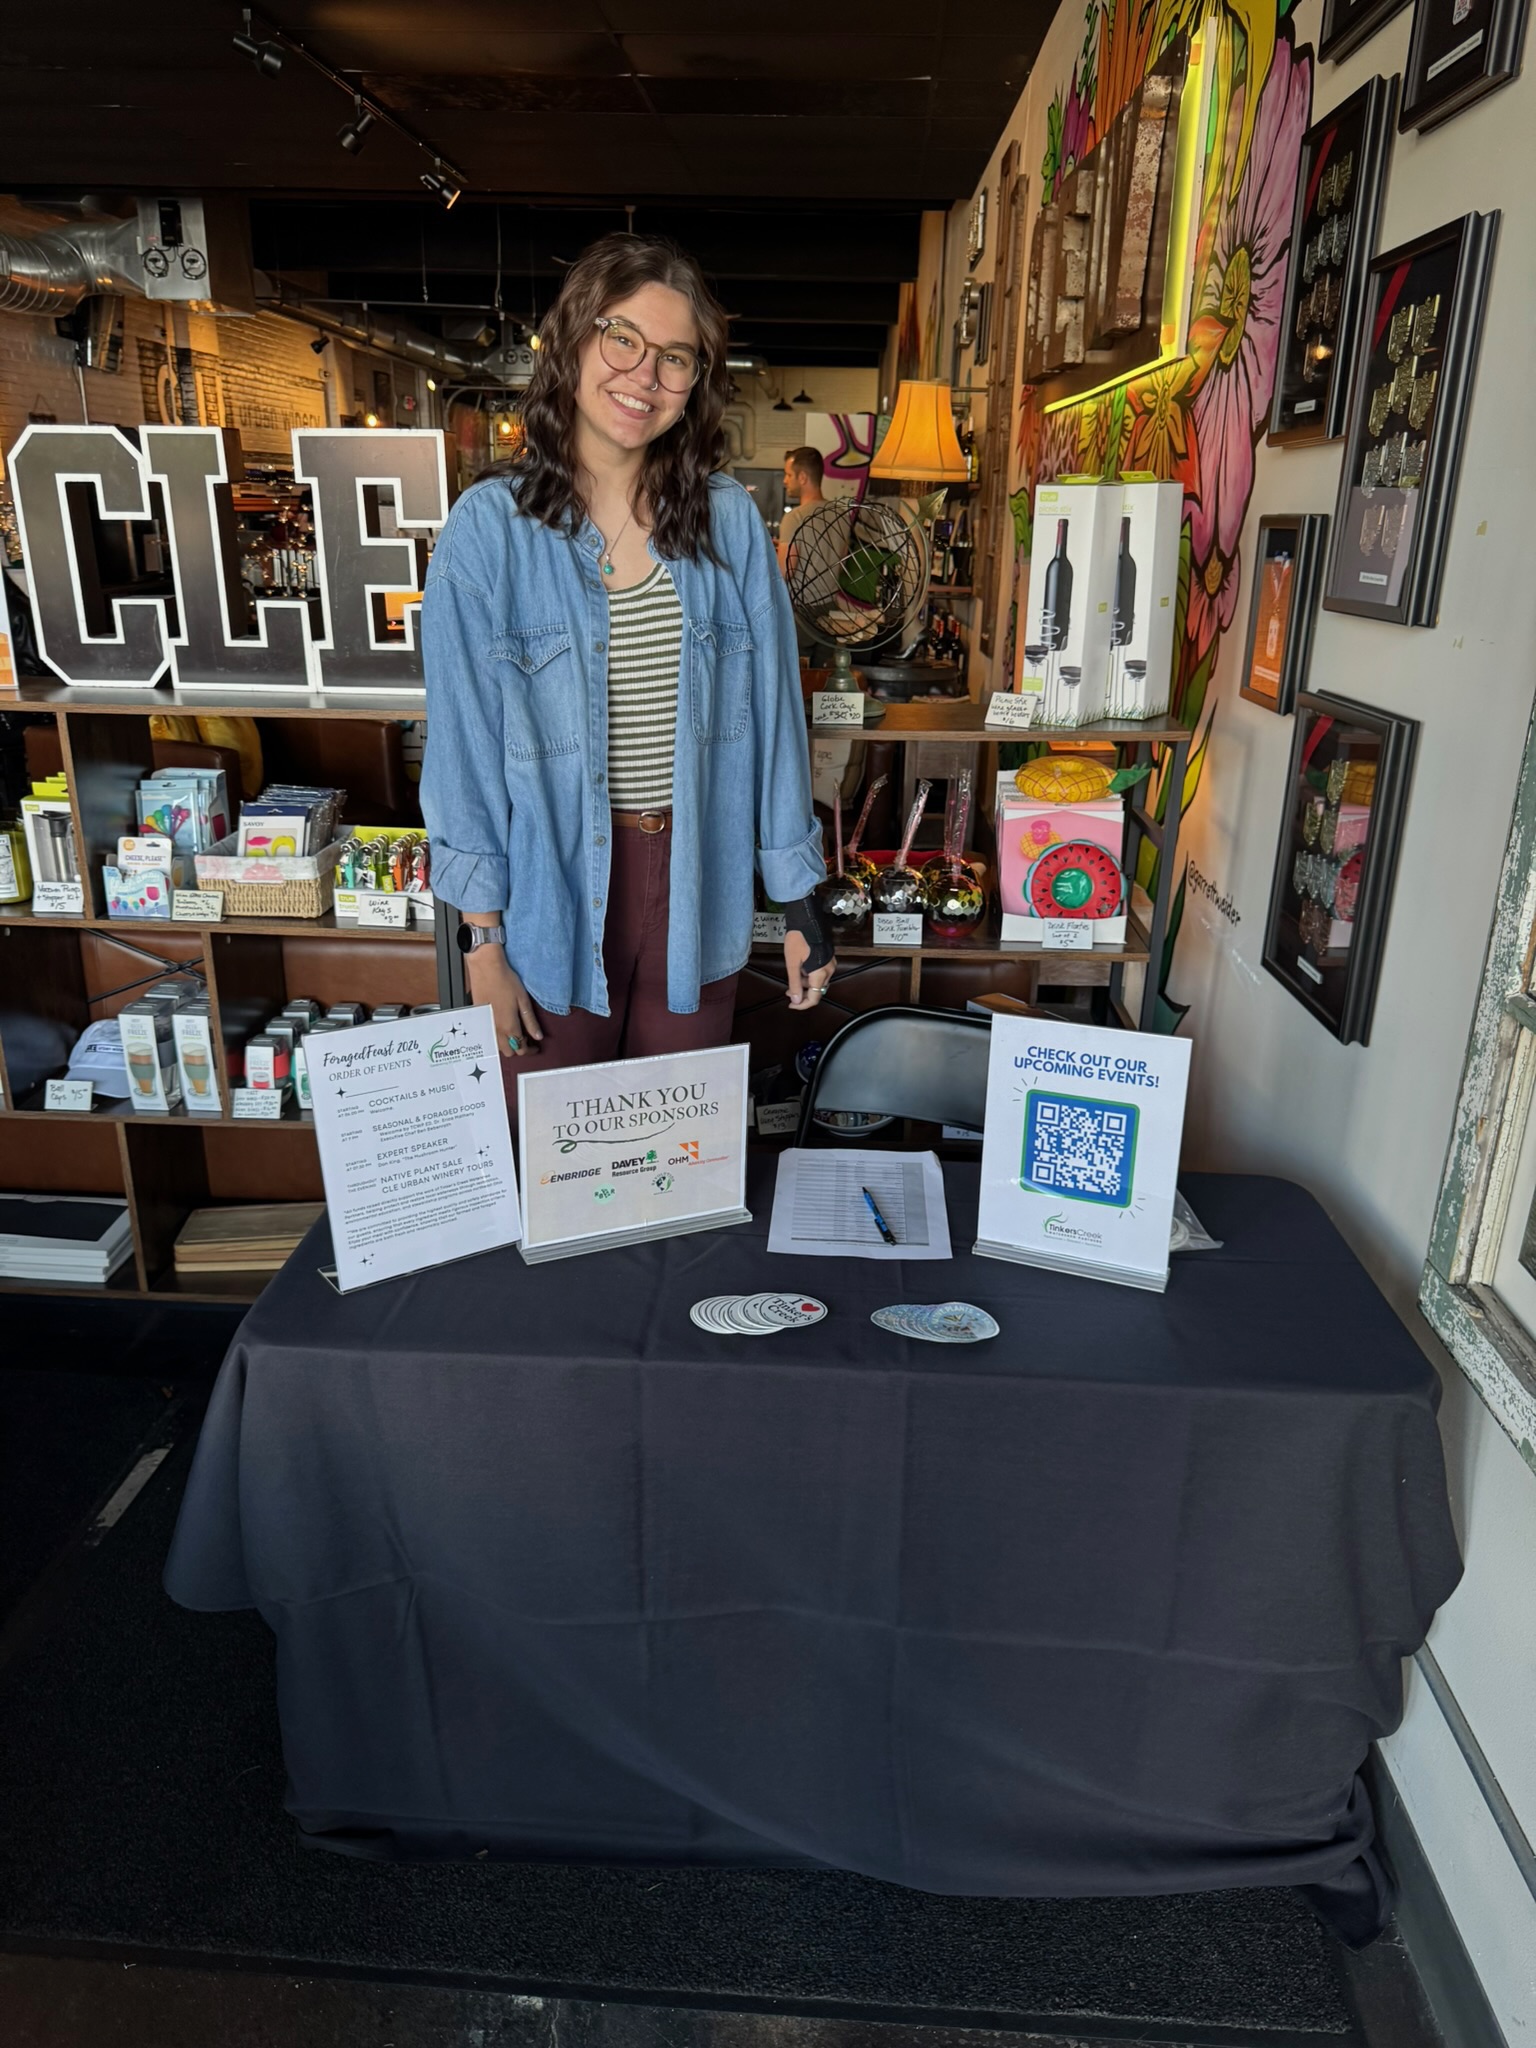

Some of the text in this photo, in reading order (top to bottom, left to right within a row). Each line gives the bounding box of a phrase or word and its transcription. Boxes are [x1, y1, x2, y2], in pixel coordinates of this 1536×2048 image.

[7, 424, 449, 696] CLE
[396, 1040, 419, 1054] 2026
[329, 1058, 412, 1082] ORDER OF EVENTS
[1027, 1046, 1147, 1073] CHECK OUT OUR
[1014, 1056, 1160, 1088] UPCOMING EVENTS!
[368, 1092, 418, 1108] COCKTAILS
[428, 1083, 456, 1095] MUSIC
[566, 1082, 708, 1119] THANK YOU
[372, 1117, 413, 1132] SEASONAL
[422, 1107, 458, 1120] FORAGED
[460, 1101, 485, 1112] FOODS
[552, 1102, 720, 1140] TO OUR SPONSORS
[376, 1137, 448, 1160] EXPERT SPEAKER
[380, 1157, 462, 1183] NATIVE PLANT SALE
[612, 1157, 646, 1170] DAVEY
[612, 1165, 656, 1178] Resource Group
[668, 1156, 689, 1166] OHM
[382, 1159, 494, 1194] CLE URBAN WINERY TOURS
[550, 1168, 602, 1184] ENBRIDGE
[768, 1304, 800, 1324] Creek
[772, 1297, 814, 1321] Tinker's
